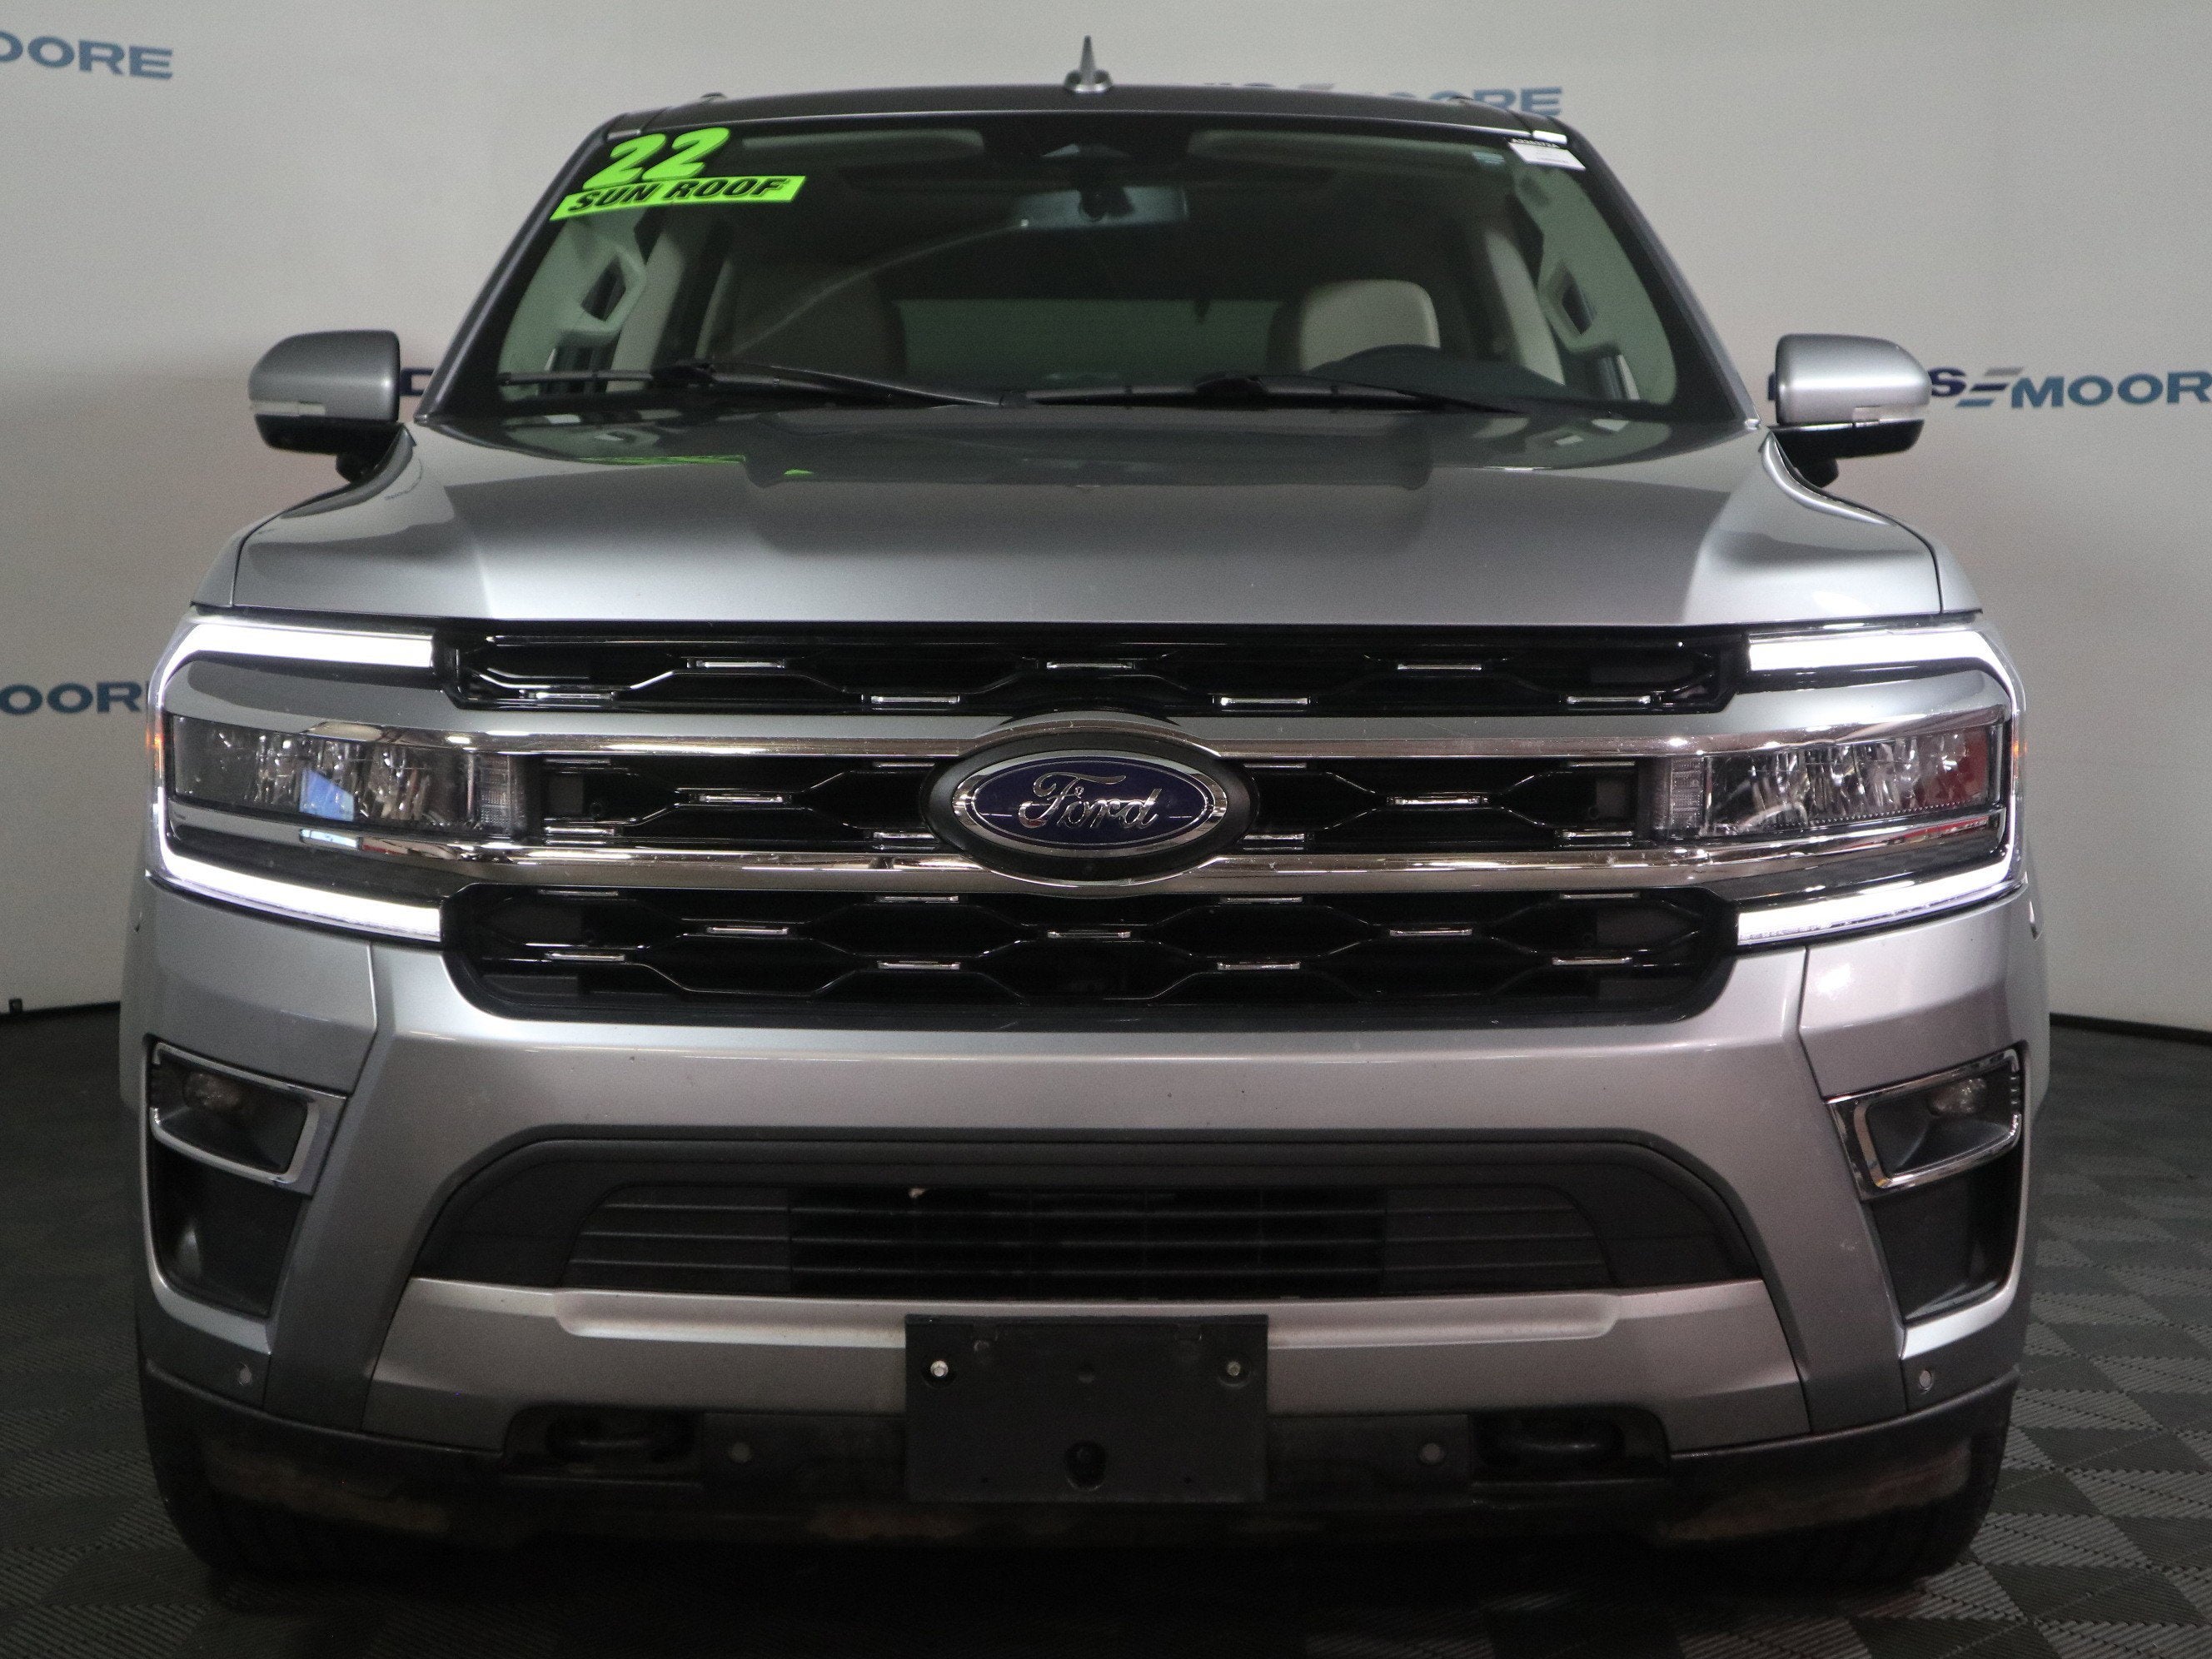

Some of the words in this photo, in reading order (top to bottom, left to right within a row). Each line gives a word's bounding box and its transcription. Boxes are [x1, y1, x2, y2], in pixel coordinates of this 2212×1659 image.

[582, 127, 730, 190] 22
[568, 182, 661, 211] SUN
[662, 177, 788, 200] ROOF
[0, 681, 147, 715] OOR
[1018, 771, 1163, 829] Ford
